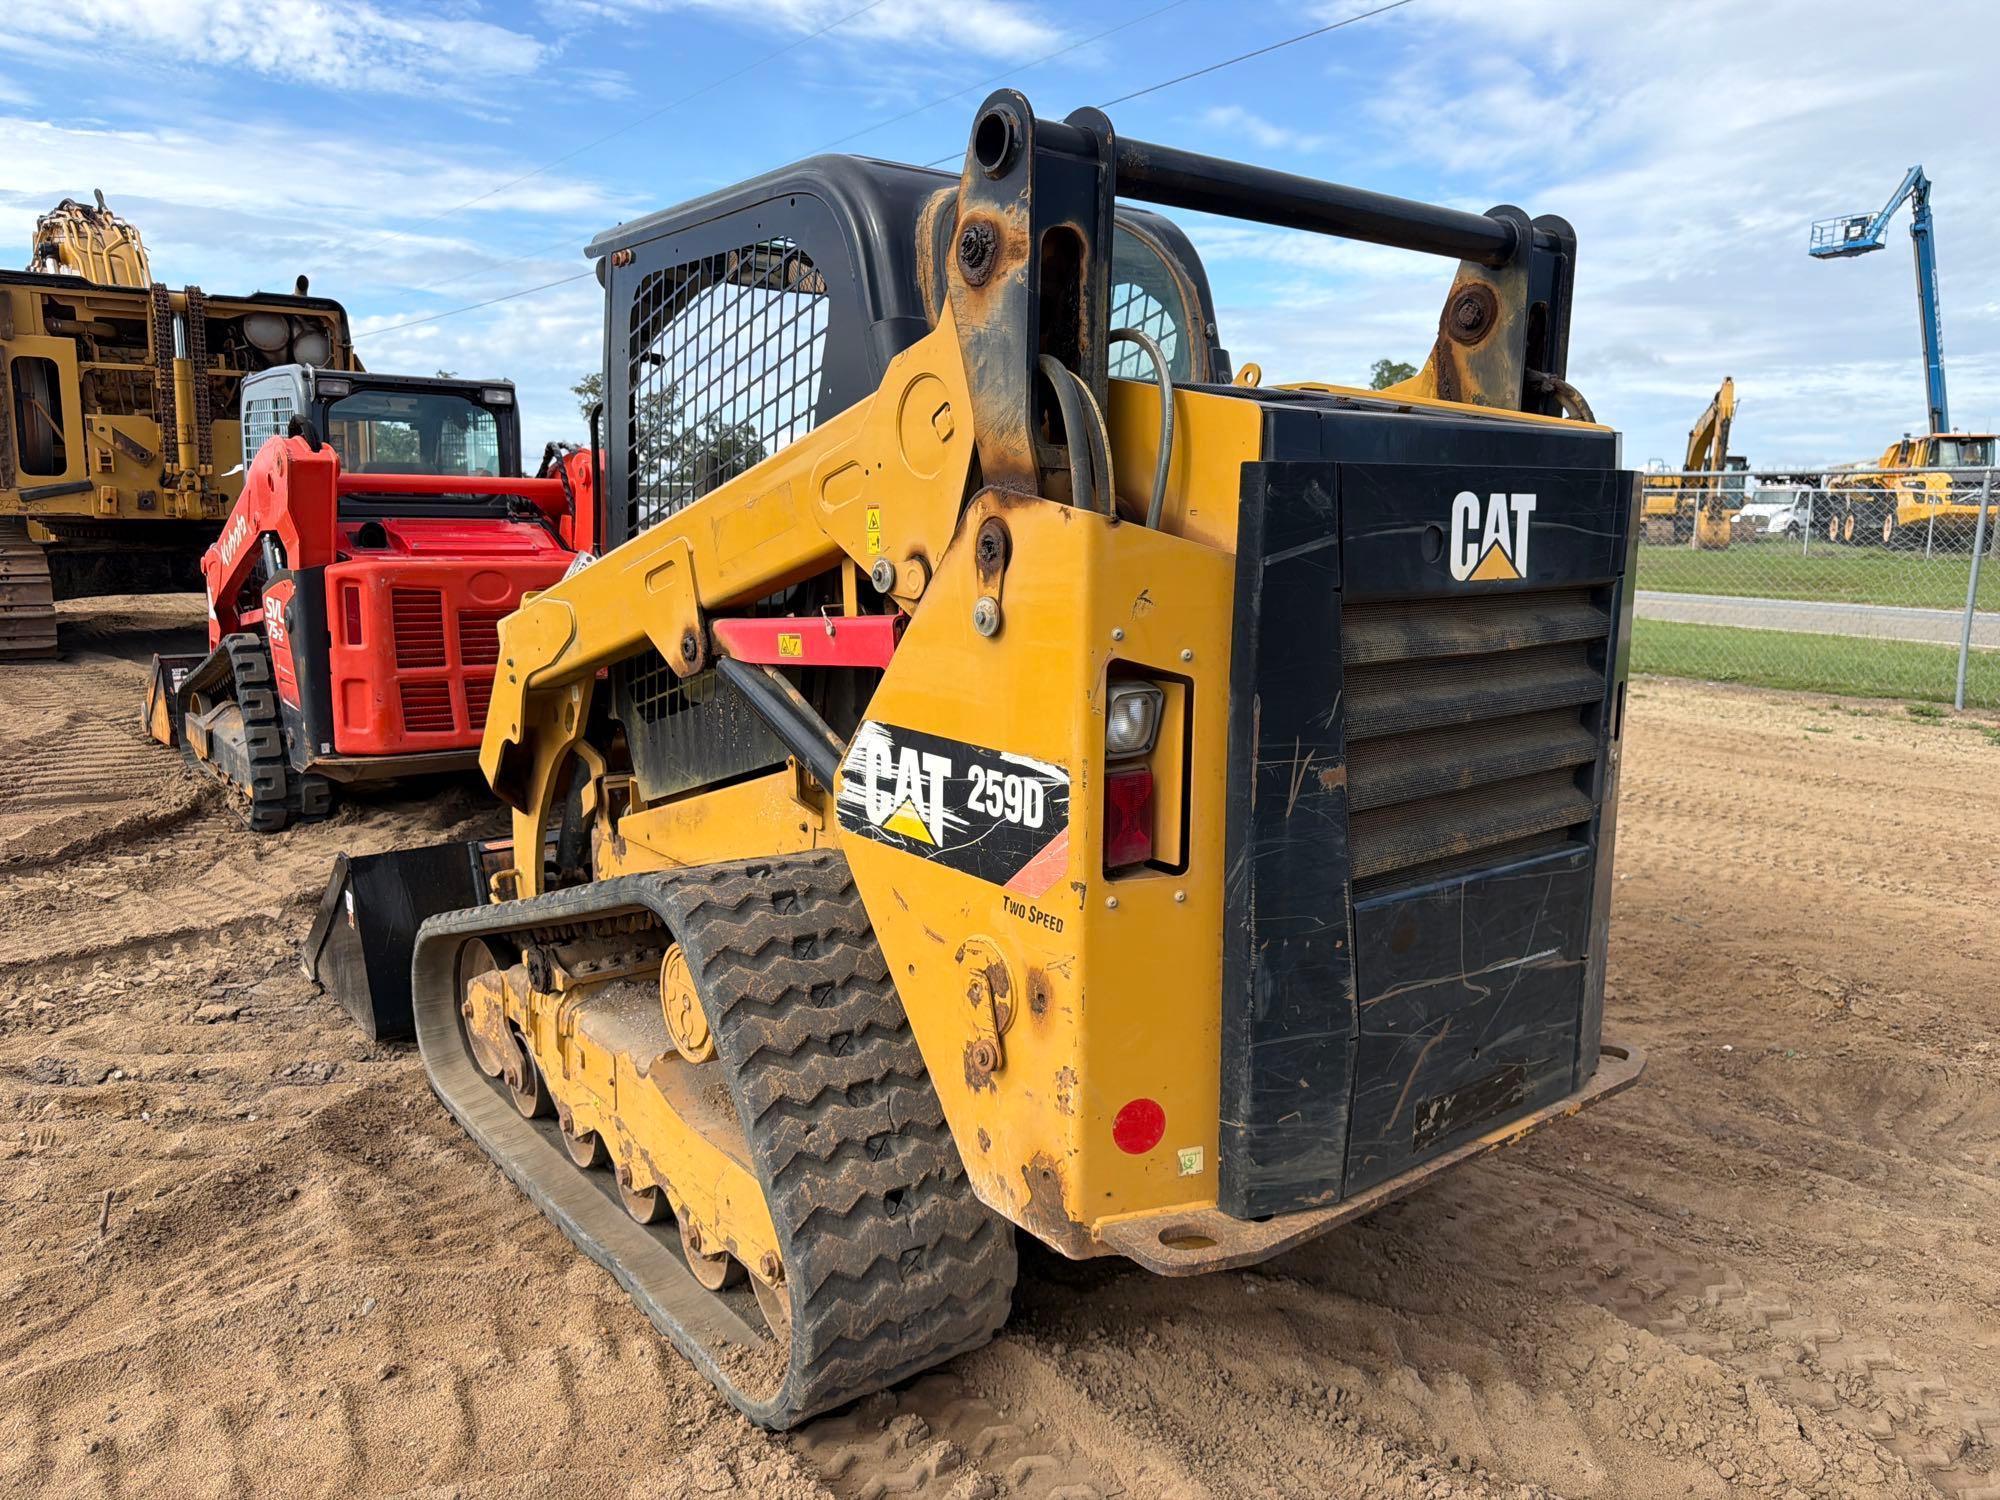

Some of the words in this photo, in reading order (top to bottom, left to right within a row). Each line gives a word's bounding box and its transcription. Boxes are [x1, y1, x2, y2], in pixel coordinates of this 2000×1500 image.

[1449, 491, 1537, 581] CAT
[265, 596, 285, 624] SVL
[865, 735, 952, 848] CAT
[967, 764, 1044, 829] 259D
